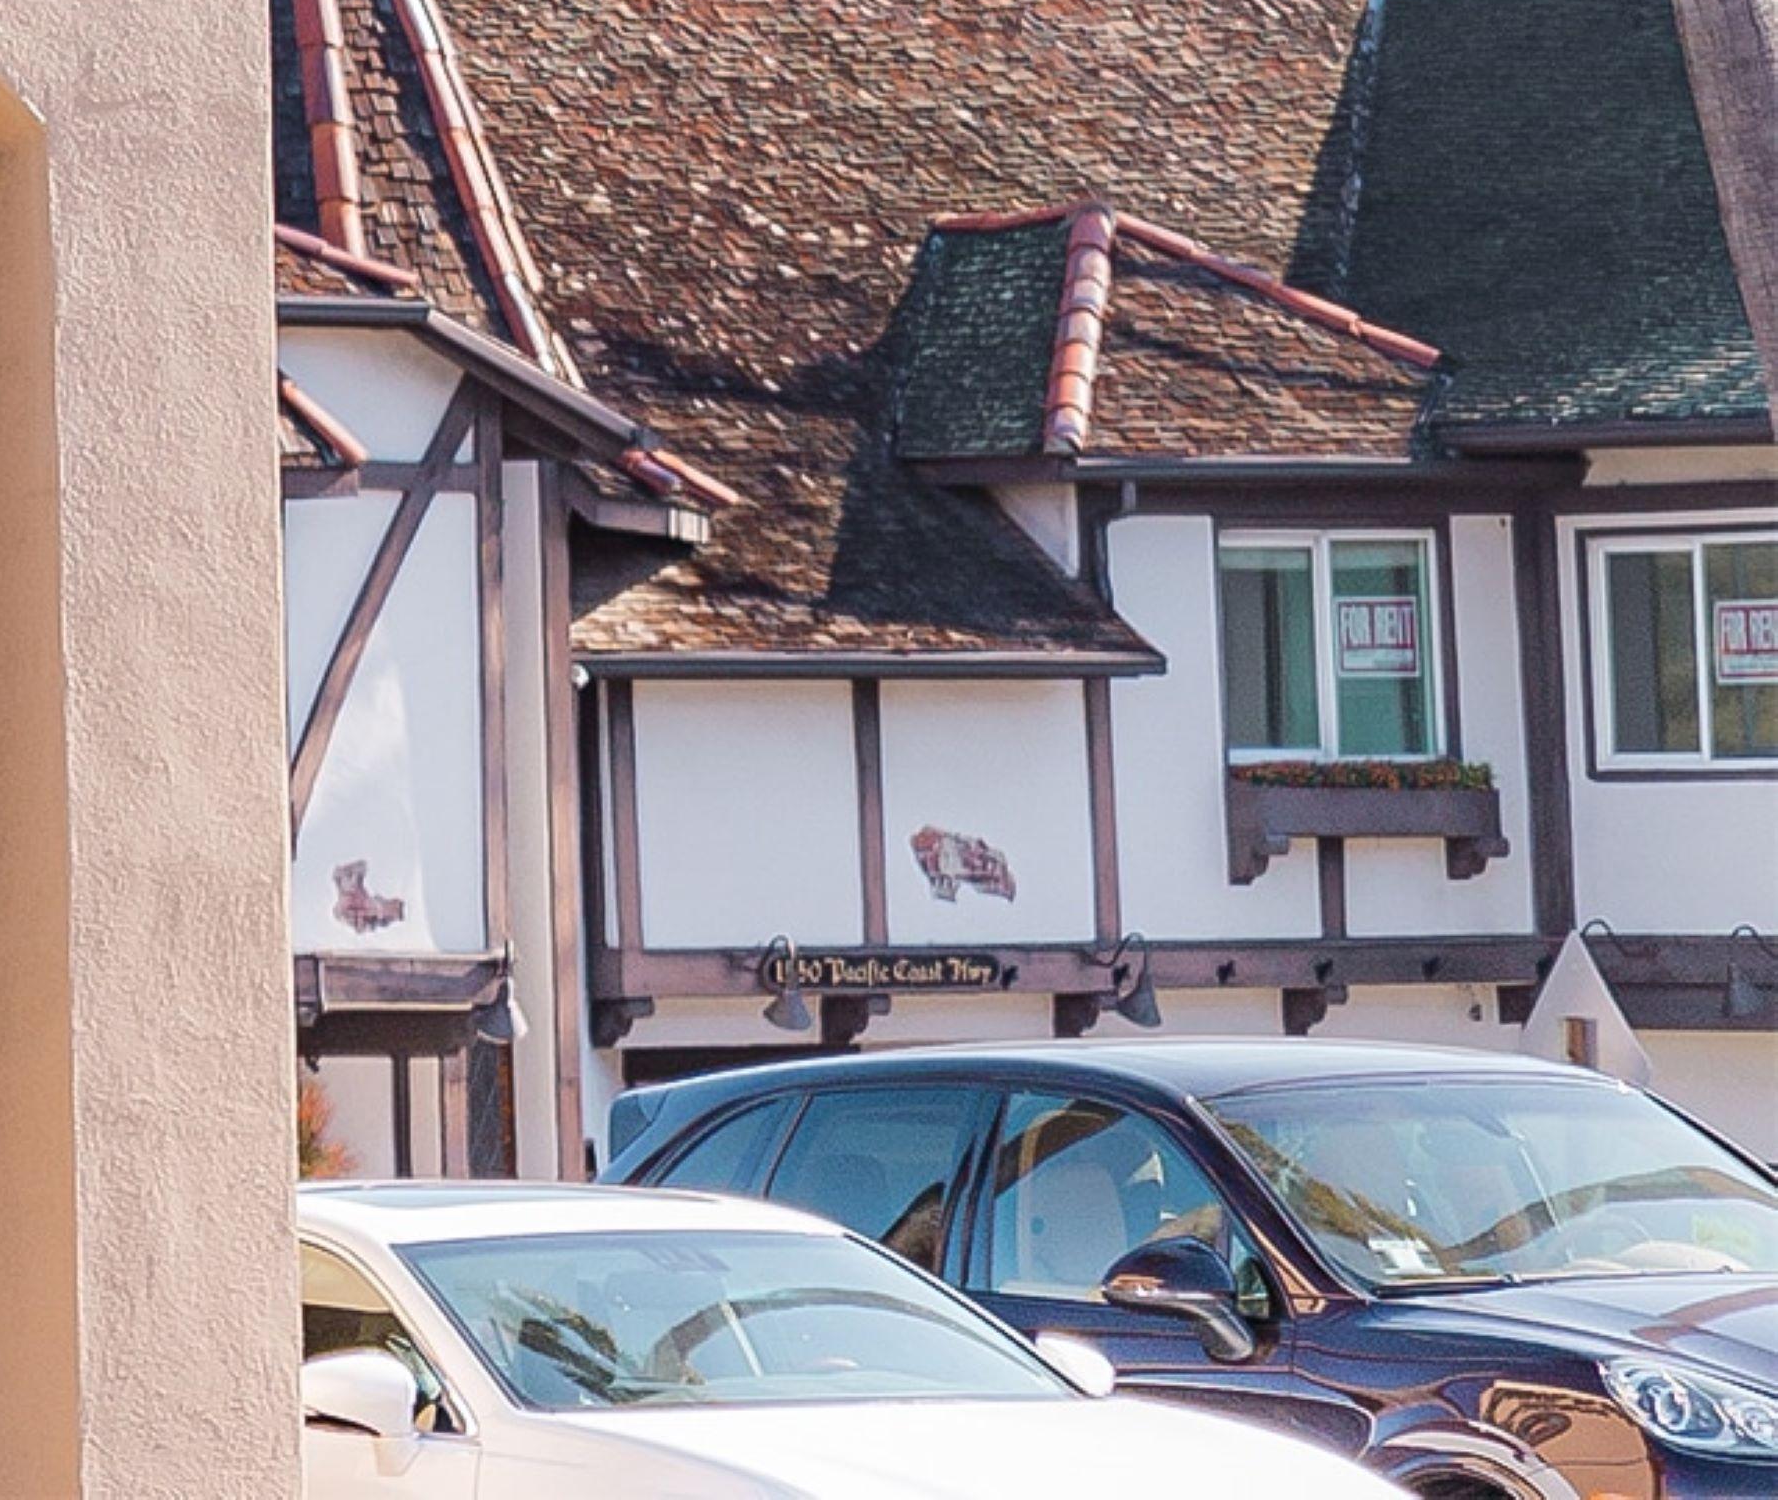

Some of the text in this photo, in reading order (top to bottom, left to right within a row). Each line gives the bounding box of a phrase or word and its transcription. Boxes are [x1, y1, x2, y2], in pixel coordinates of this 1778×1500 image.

[824, 957, 891, 988] Pacific
[892, 958, 943, 984] Coast
[946, 956, 993, 988] Hwy
